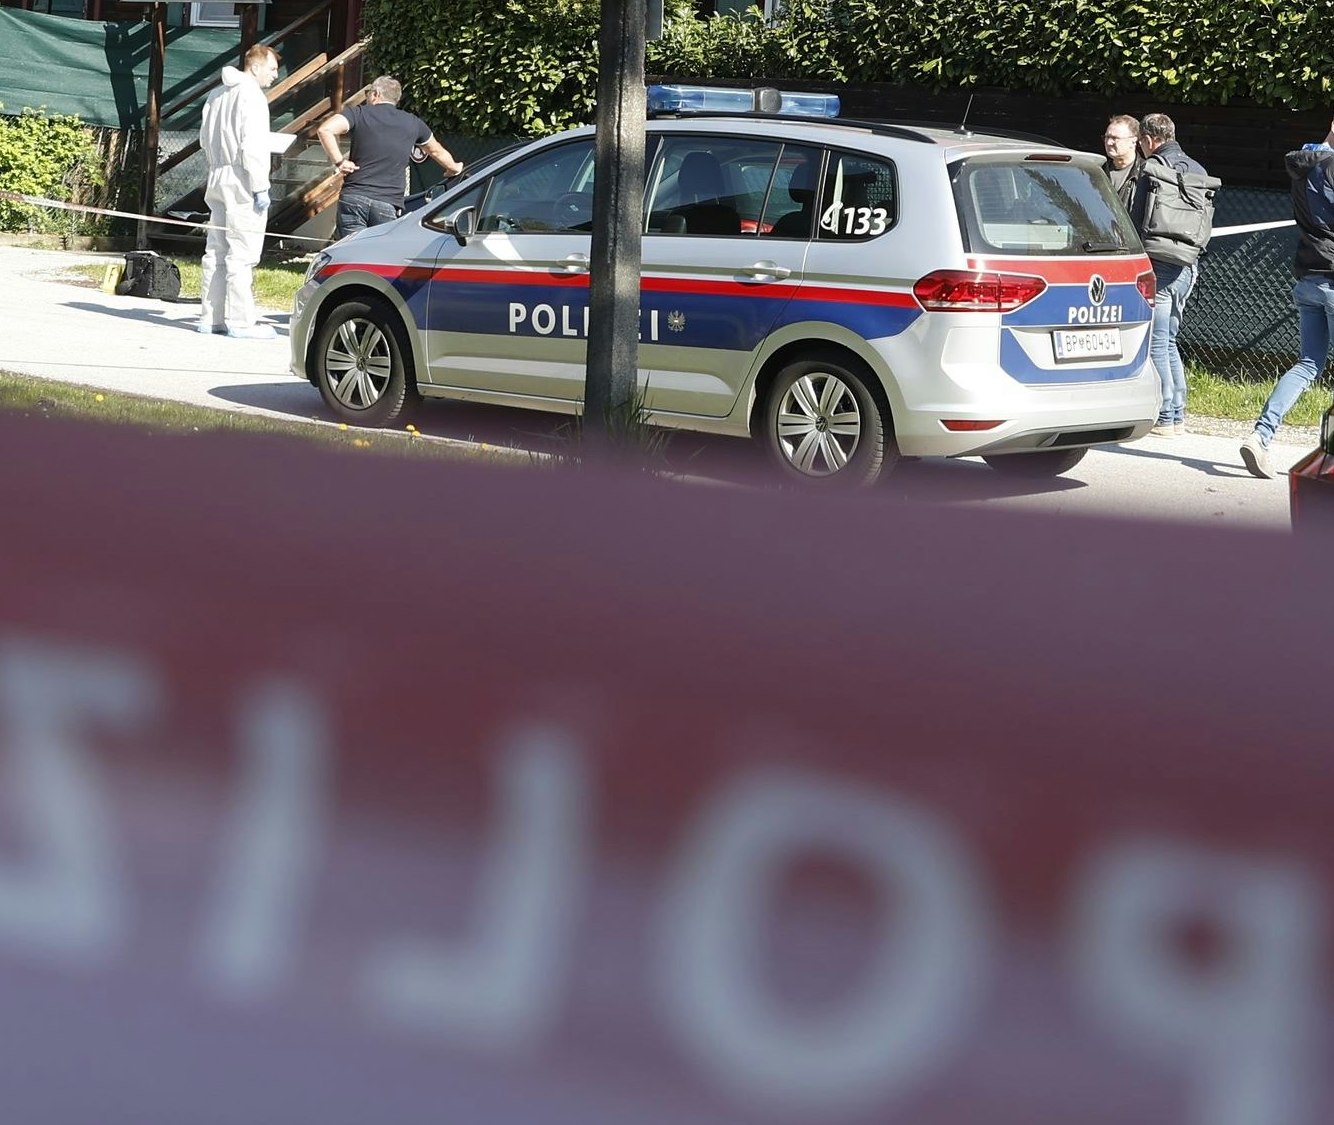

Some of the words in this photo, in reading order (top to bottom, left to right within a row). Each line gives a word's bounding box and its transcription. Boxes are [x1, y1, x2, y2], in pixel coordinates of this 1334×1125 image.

[844, 207, 887, 235] 133
[509, 302, 659, 342] POLII
[1068, 305, 1123, 324] POLIZEI
